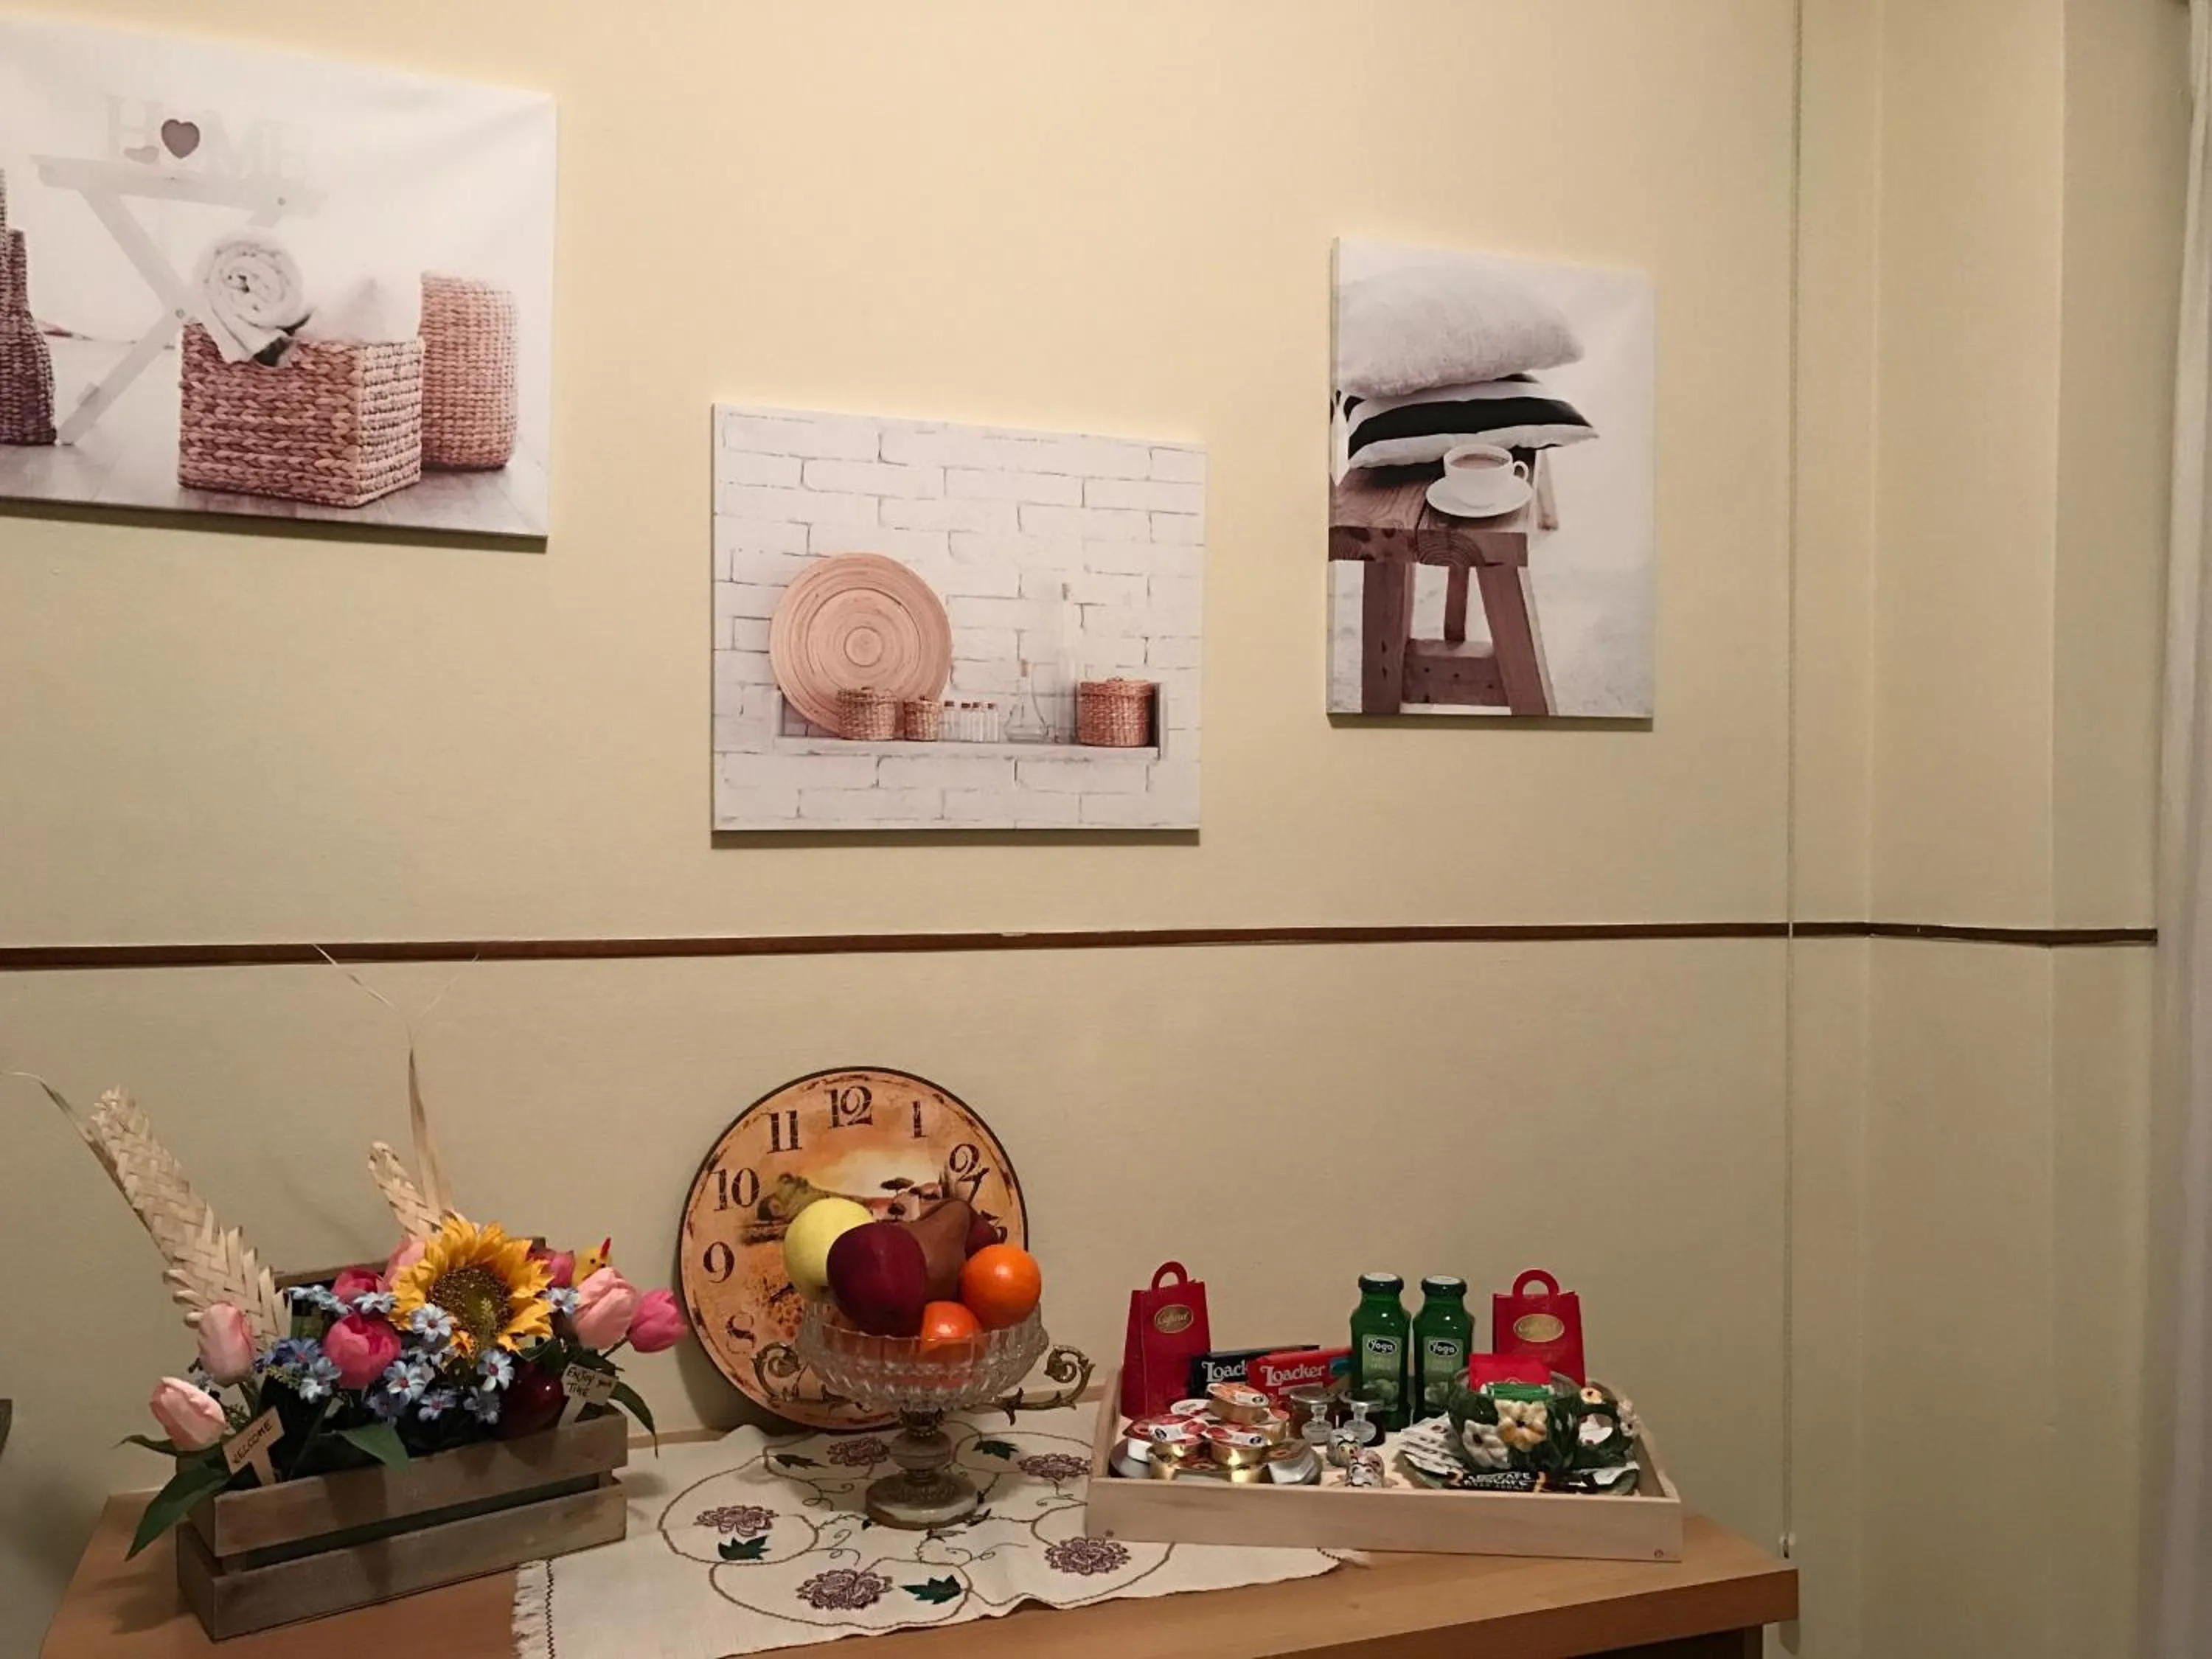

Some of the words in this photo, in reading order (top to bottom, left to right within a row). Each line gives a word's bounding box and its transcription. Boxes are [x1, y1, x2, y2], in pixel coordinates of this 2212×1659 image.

[824, 1085, 873, 1129] 12
[911, 1099, 929, 1139] 1
[761, 1110, 803, 1154] 11
[710, 1168, 760, 1211] 10
[703, 1241, 735, 1284] 9
[1370, 1338, 1394, 1354] Yoga
[1433, 1341, 1455, 1356] Yoga
[1259, 1363, 1326, 1387] Loacker
